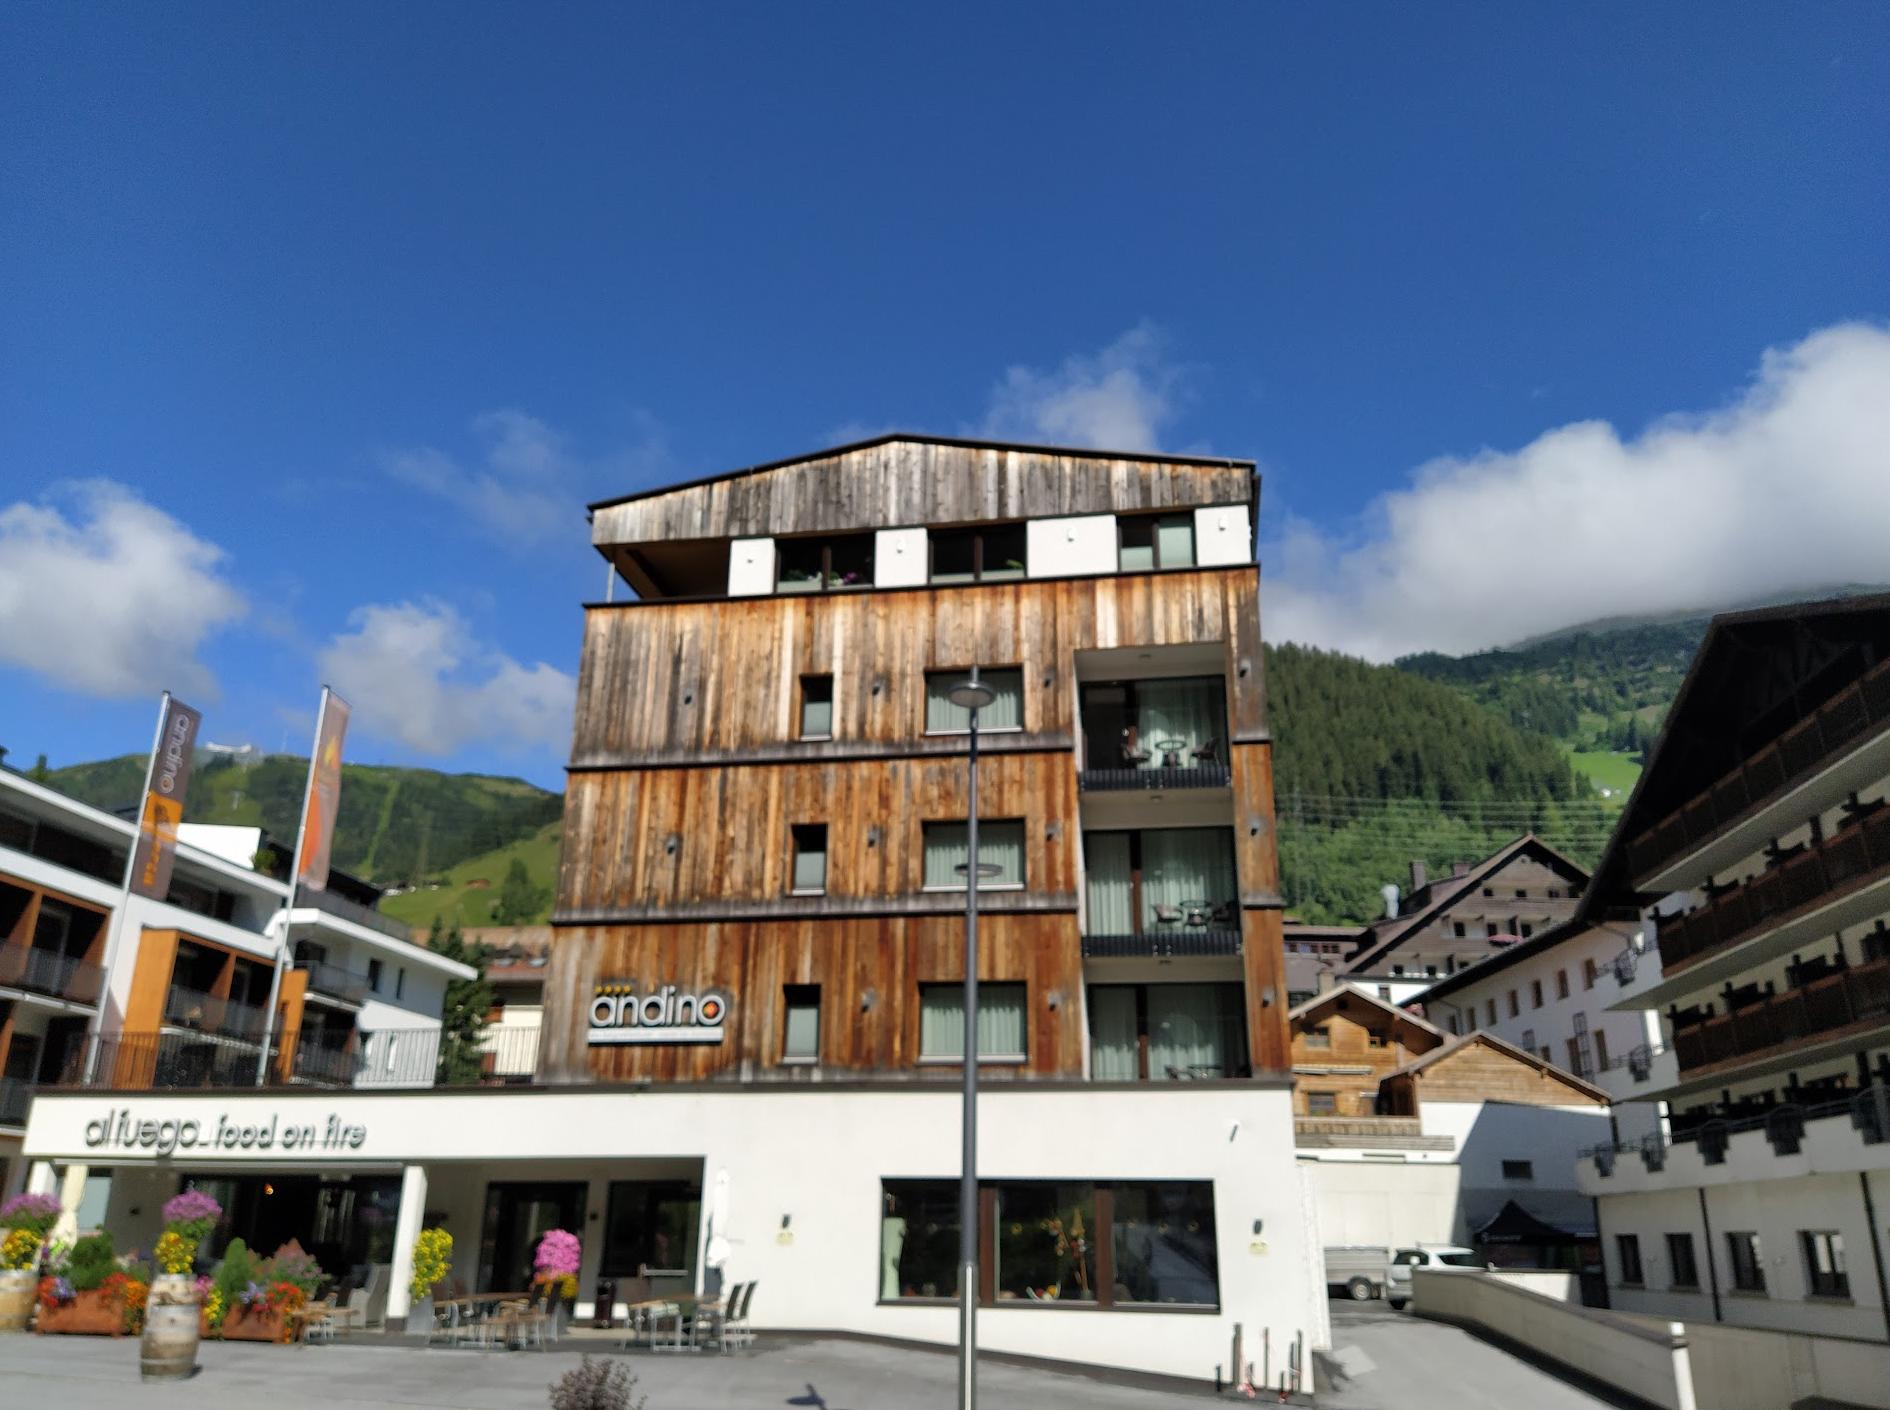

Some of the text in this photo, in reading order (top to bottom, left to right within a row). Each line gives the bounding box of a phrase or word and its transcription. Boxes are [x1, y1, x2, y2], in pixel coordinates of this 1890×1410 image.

[160, 714, 190, 793] andino
[589, 985, 726, 1027] andino
[282, 1124, 316, 1148] on
[323, 1113, 366, 1148] fire
